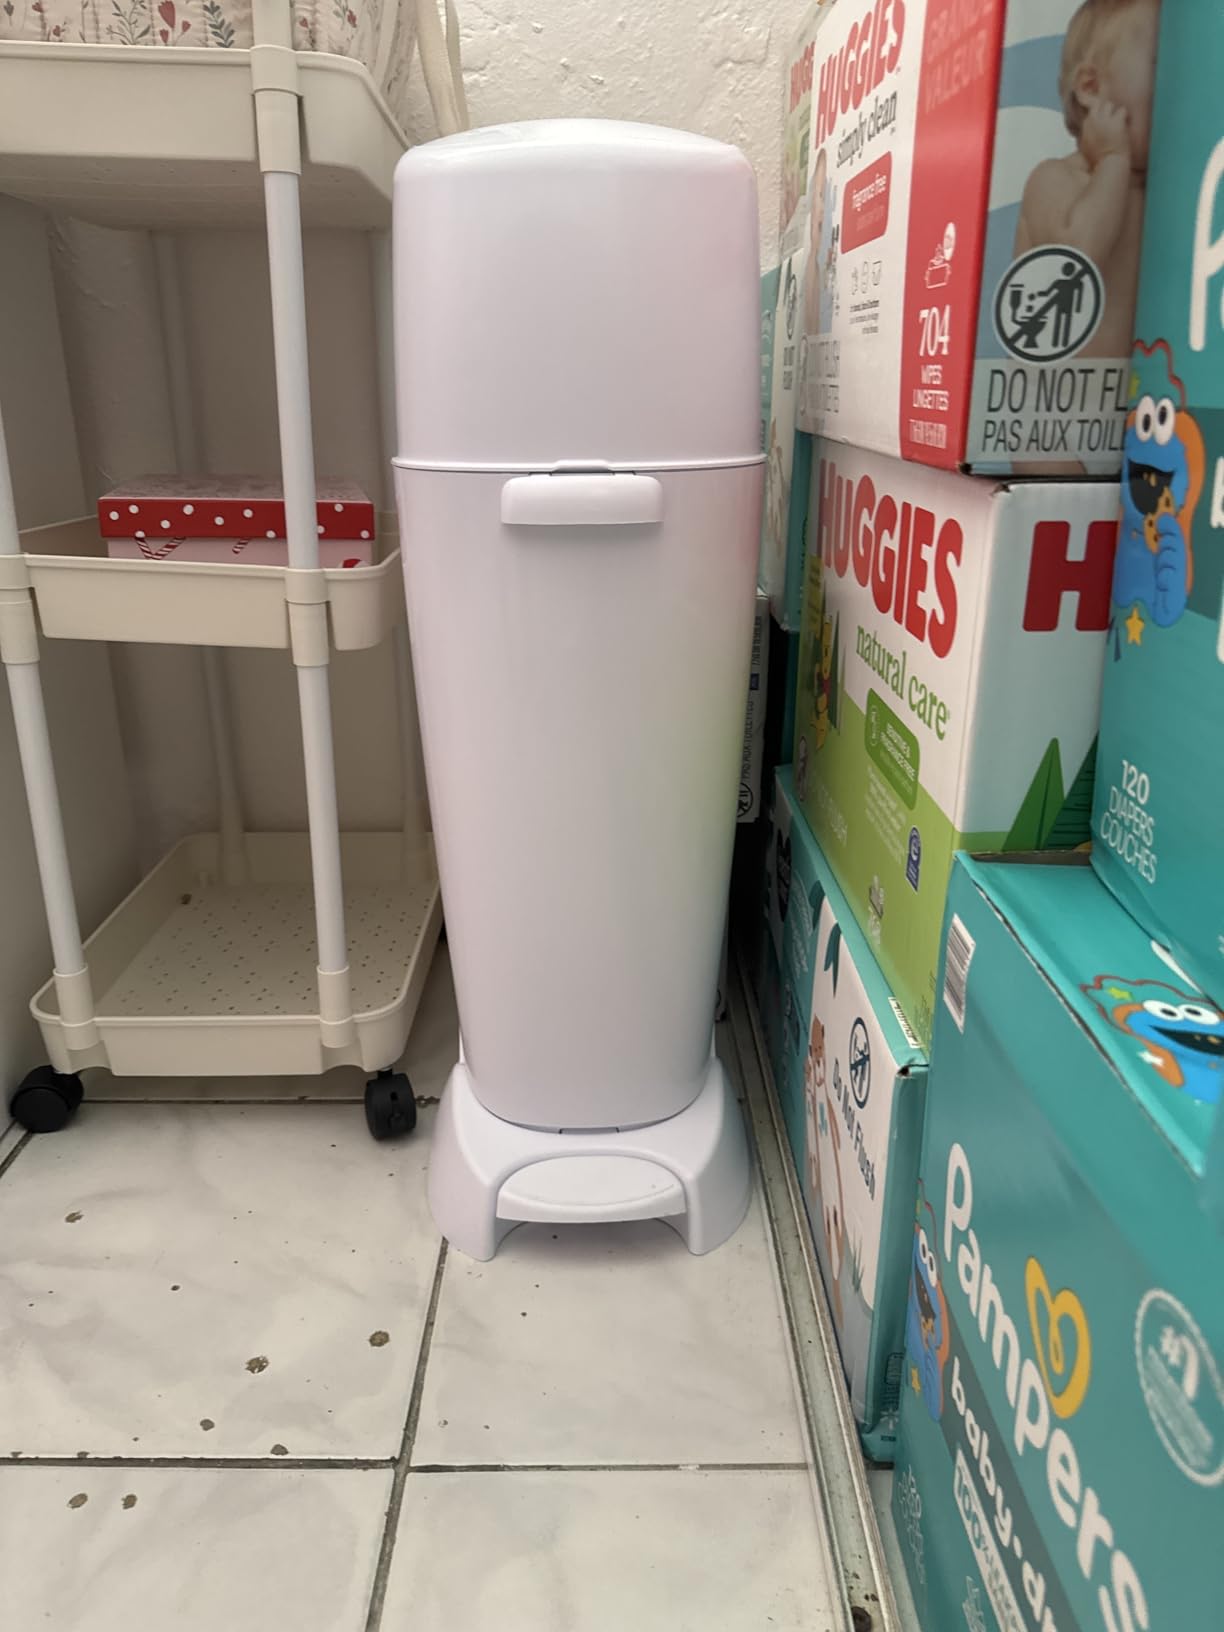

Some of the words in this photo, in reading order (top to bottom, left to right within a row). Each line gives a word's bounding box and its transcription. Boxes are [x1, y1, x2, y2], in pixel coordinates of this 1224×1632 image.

[815, 0, 905, 149] HUGGIES
[836, 112, 867, 168] simply
[867, 91, 897, 142] clean
[918, 304, 950, 357] 704
[987, 368, 1028, 413] DO
[1035, 368, 1095, 413] NOT
[982, 419, 1023, 452] PAS
[1026, 419, 1072, 452] AUX
[817, 458, 965, 660] HUGGIES
[856, 625, 907, 700] natural
[908, 675, 947, 741] care
[1109, 785, 1155, 847] DIAPERS
[1122, 759, 1150, 806] 120
[1100, 811, 1157, 884] COUCHES
[944, 1143, 1149, 1632] Pampers
